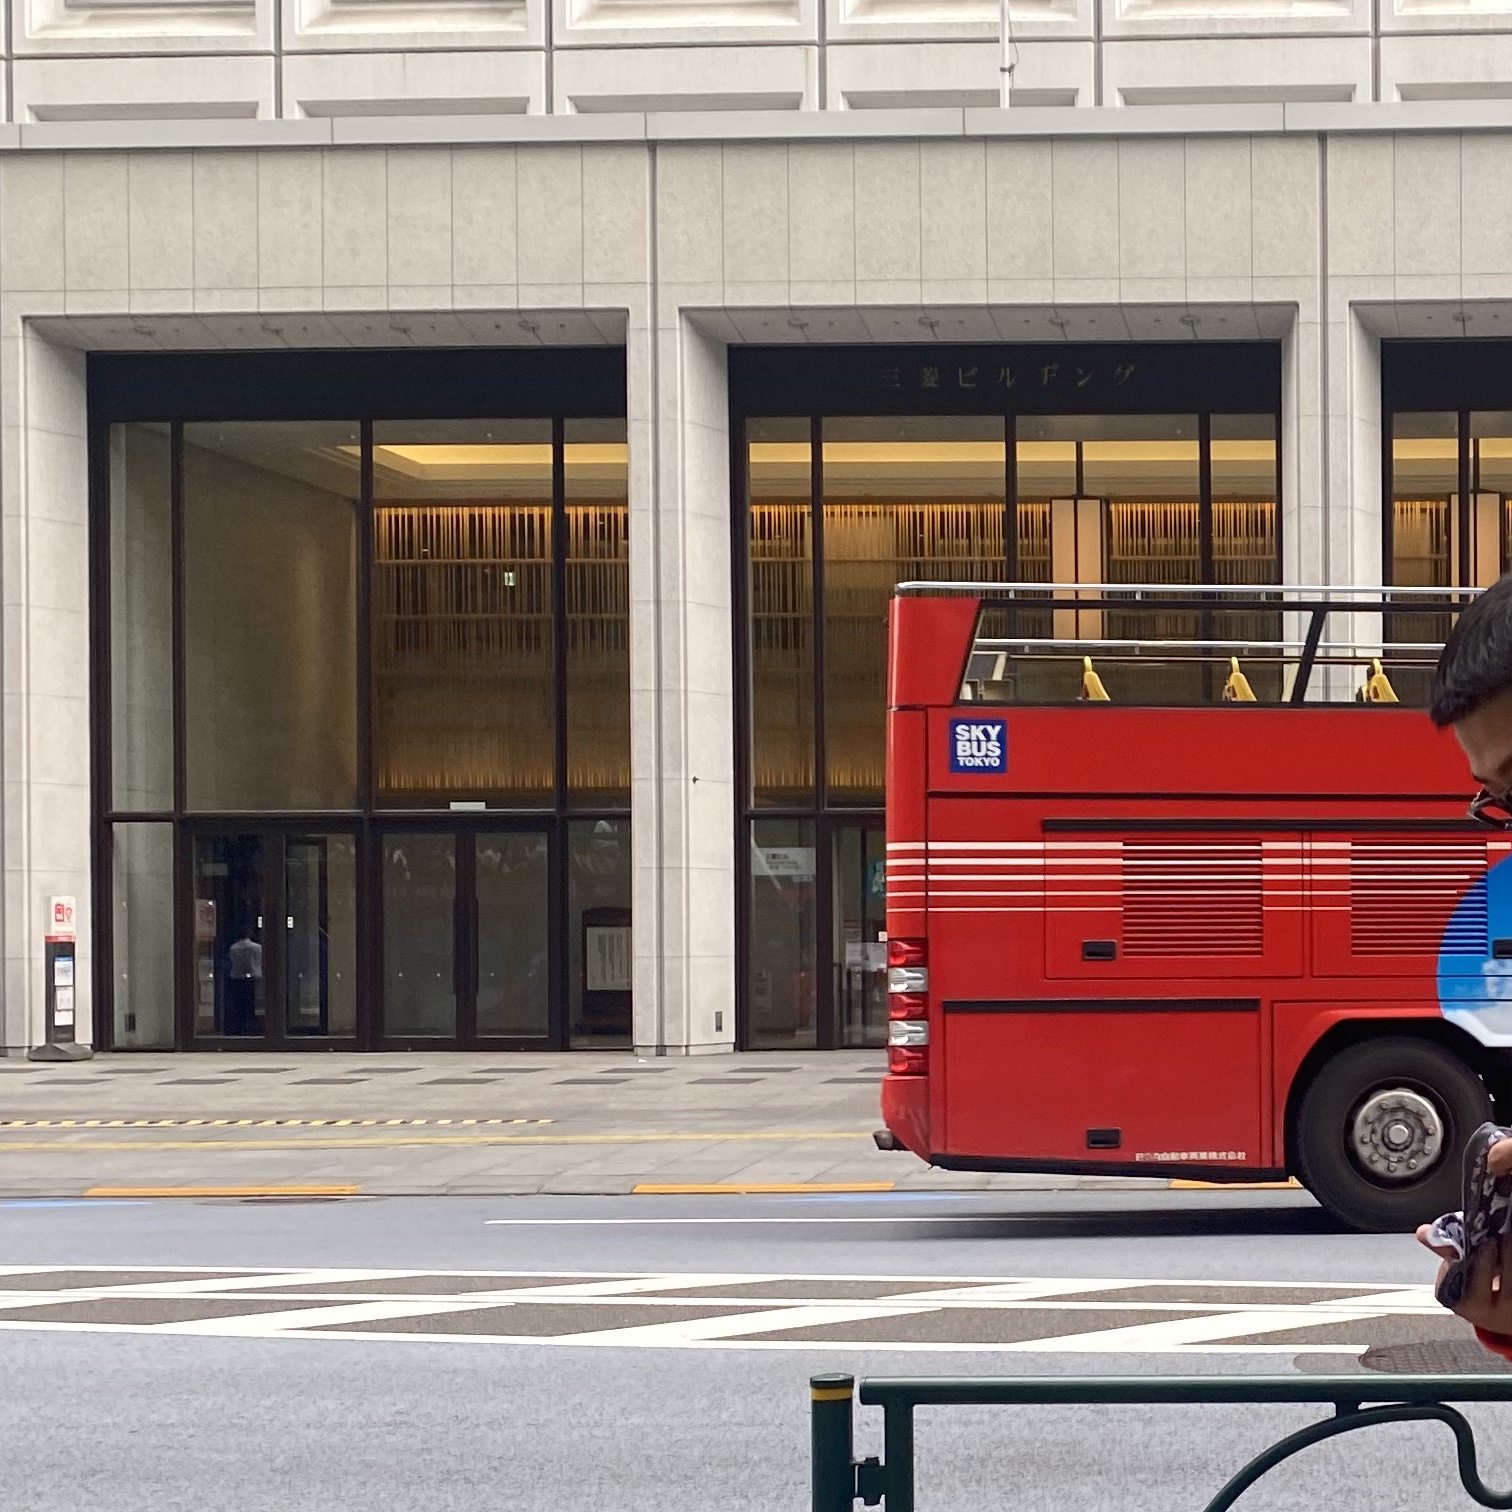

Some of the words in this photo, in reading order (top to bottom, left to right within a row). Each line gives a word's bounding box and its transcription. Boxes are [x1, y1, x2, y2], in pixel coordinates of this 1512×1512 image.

[955, 724, 1002, 741] SKY
[956, 741, 1001, 757] BUS
[957, 757, 1001, 767] TOKYO
